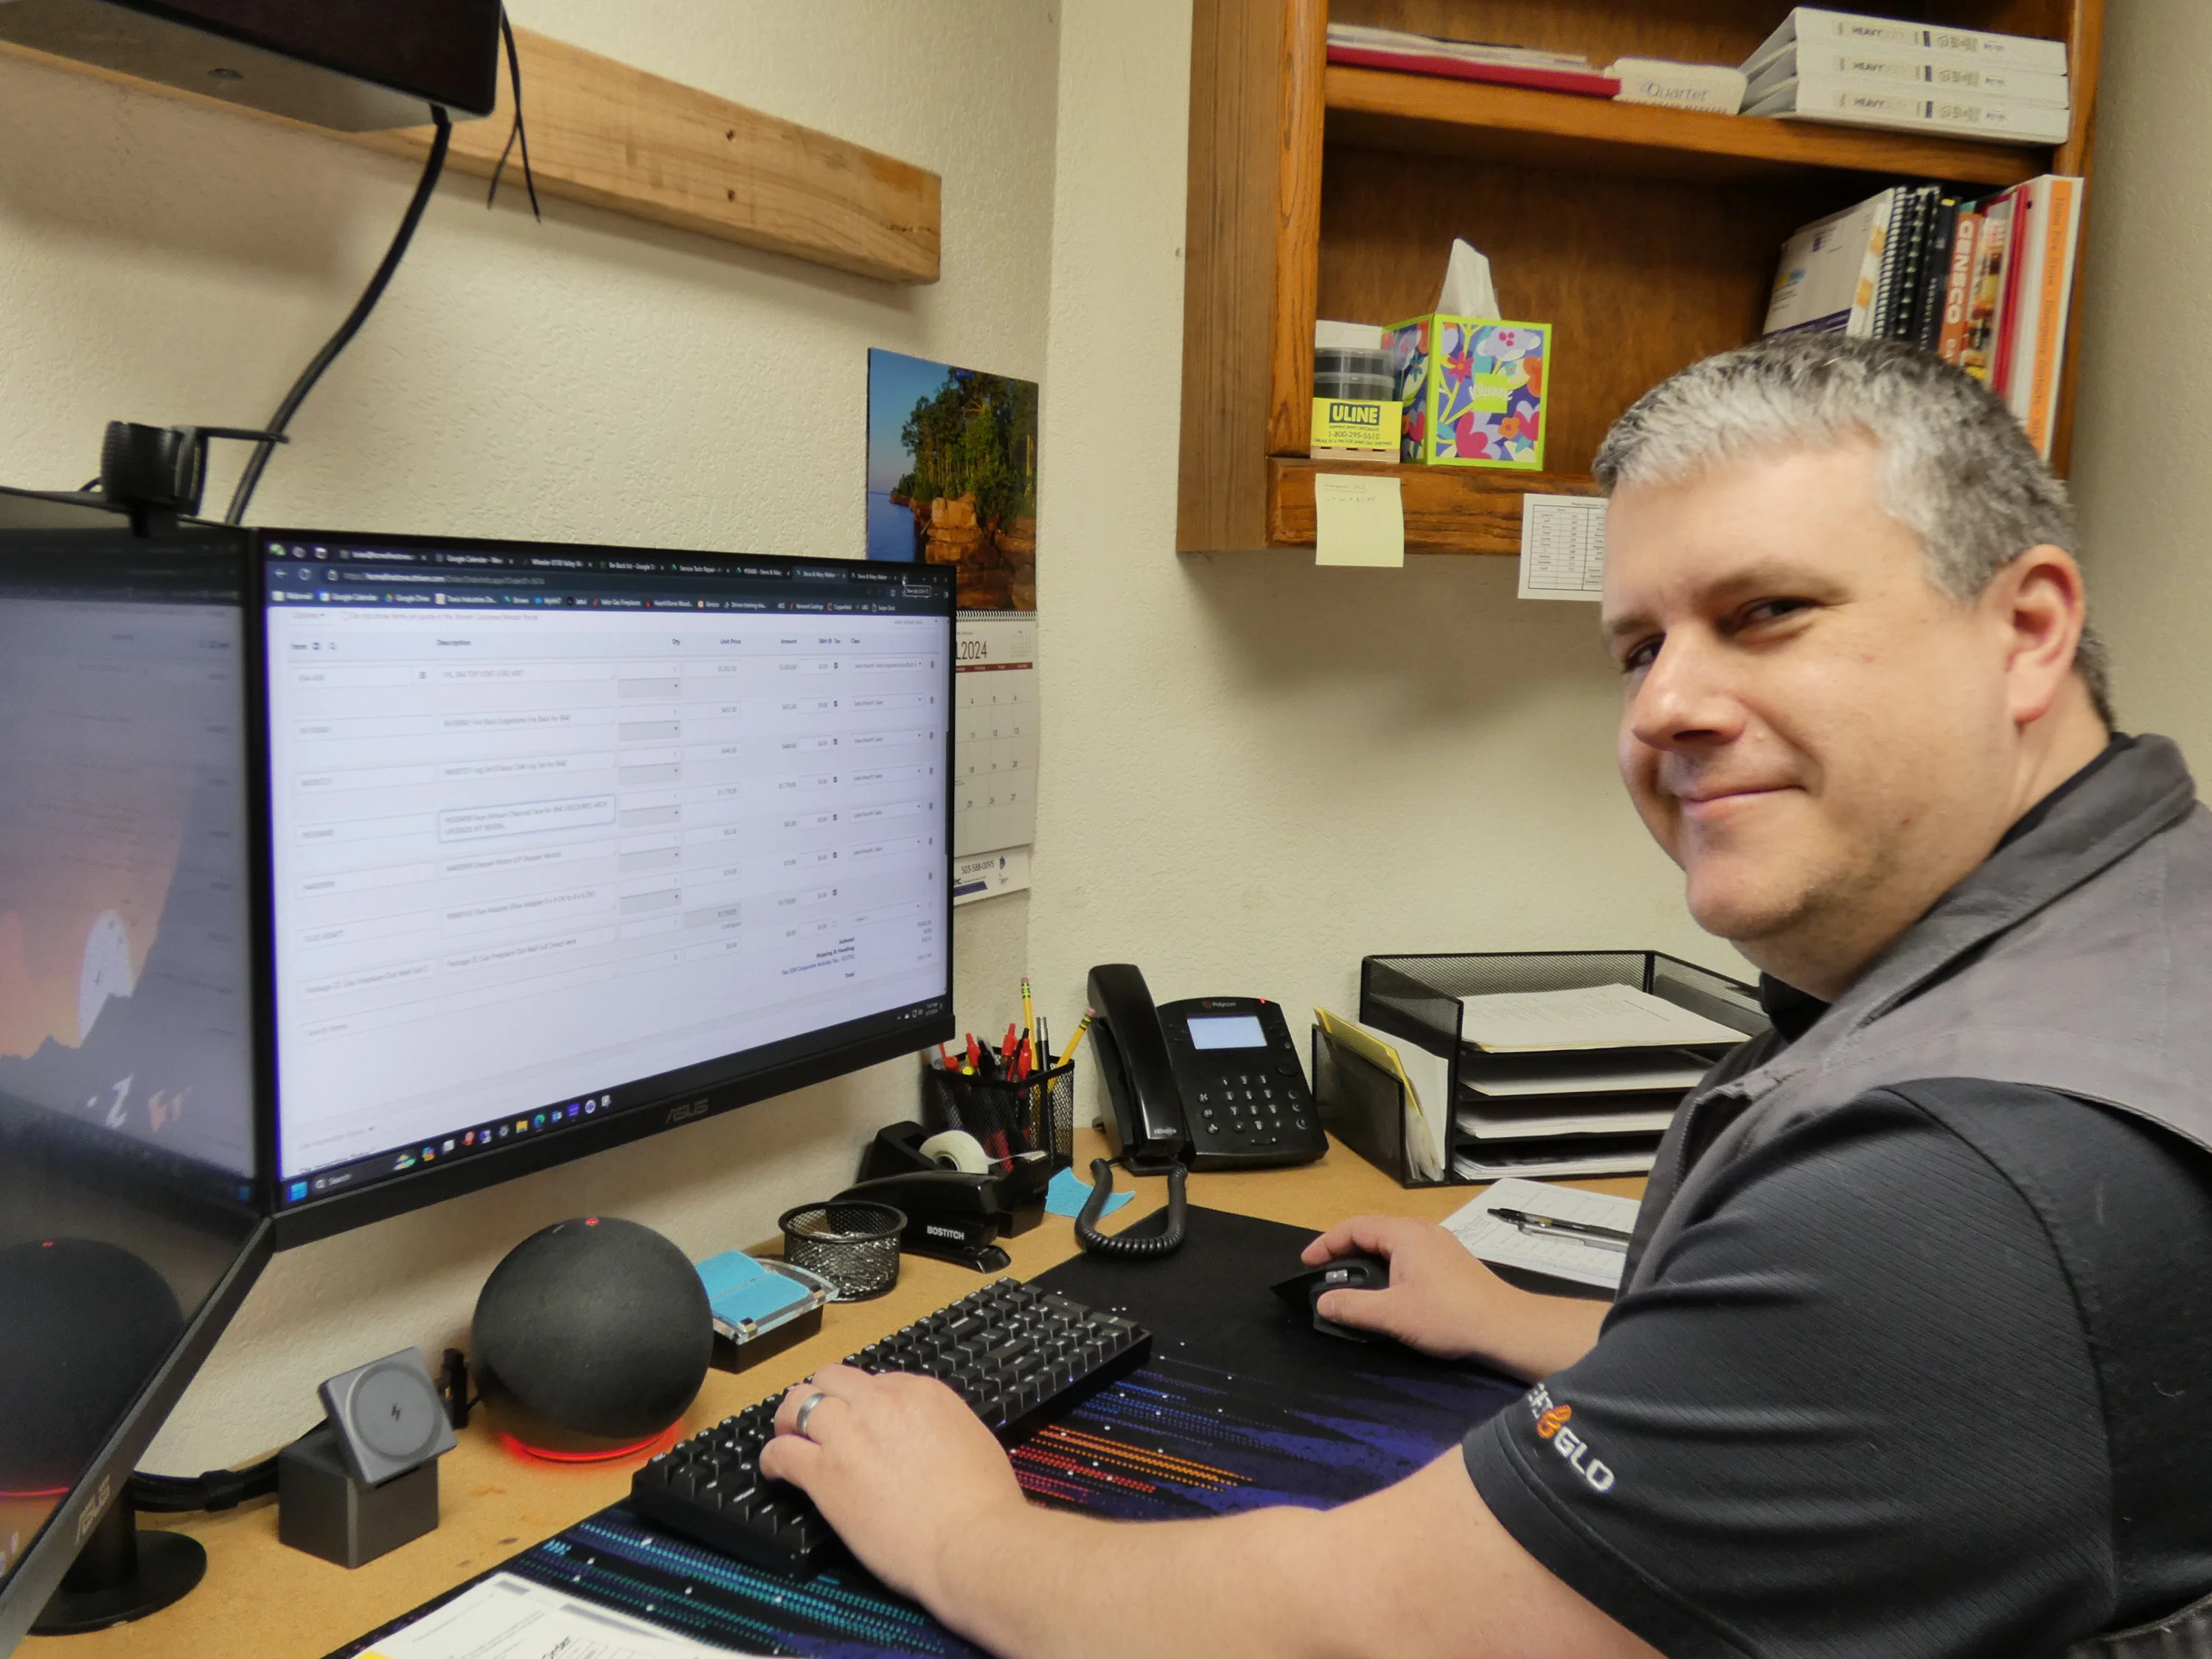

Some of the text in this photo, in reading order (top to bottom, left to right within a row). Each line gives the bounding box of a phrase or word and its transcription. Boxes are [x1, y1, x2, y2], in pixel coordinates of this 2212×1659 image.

[1647, 82, 1708, 102] Quartet
[1332, 405, 1379, 424] ULINE
[1328, 431, 1380, 440] 1-800-295-5510
[961, 640, 987, 660] 2024
[961, 859, 995, 875] 503-588-0095
[665, 1097, 709, 1124] ASUS
[926, 1225, 965, 1240] BOSTITCH
